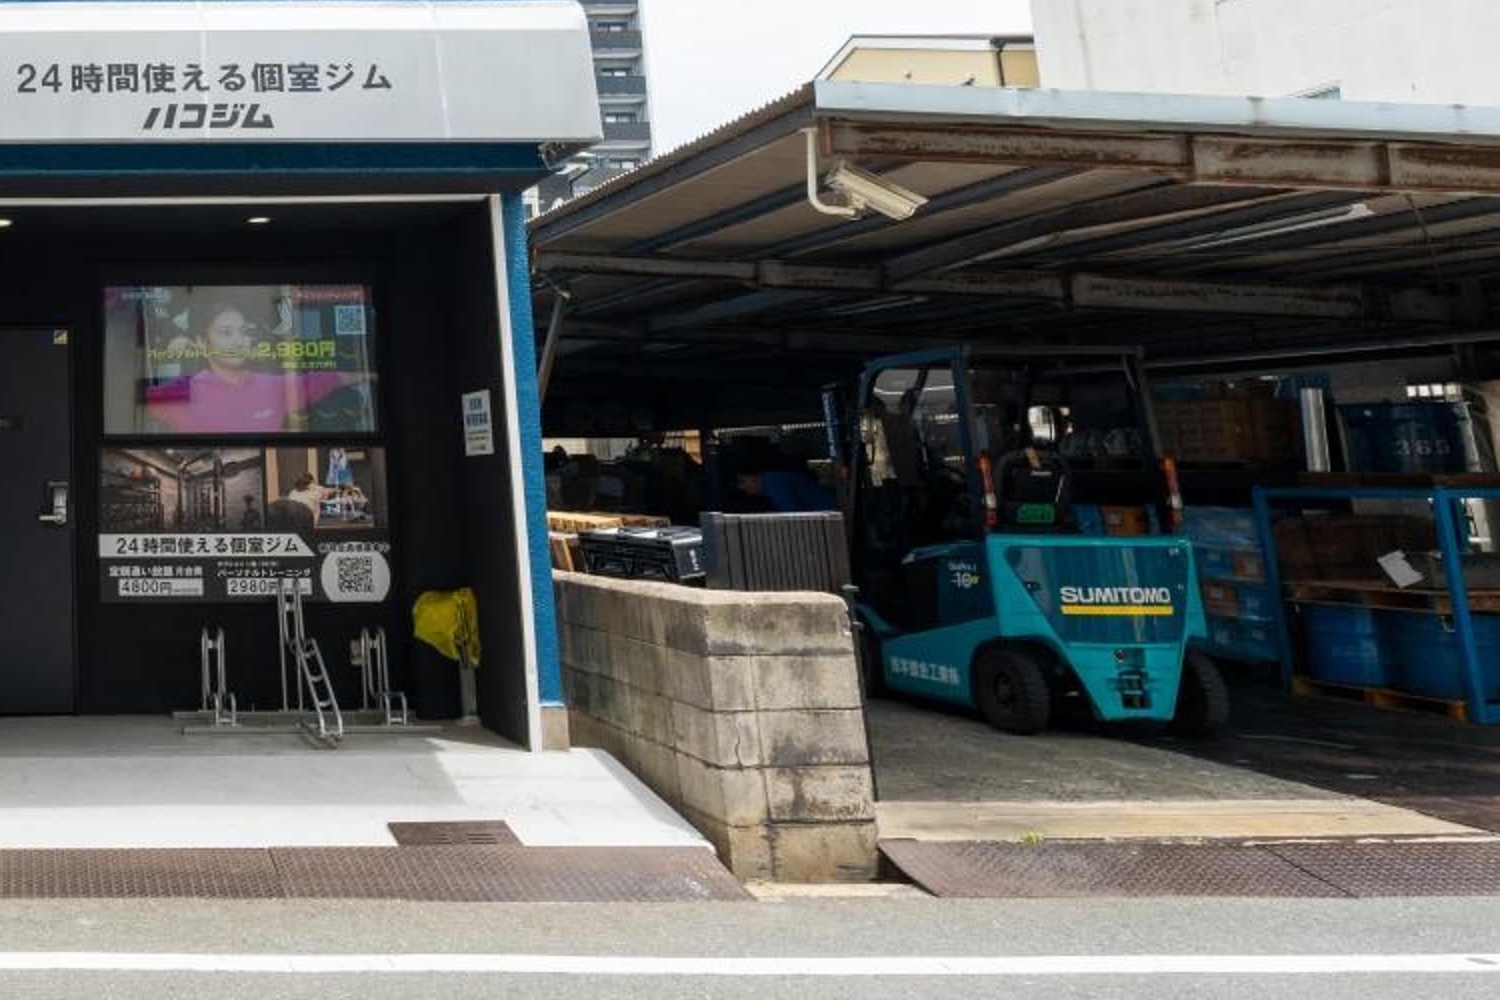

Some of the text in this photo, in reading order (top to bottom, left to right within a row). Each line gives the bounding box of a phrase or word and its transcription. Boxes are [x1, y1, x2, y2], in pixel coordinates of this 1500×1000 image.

[16, 62, 392, 94] 24時間使える個室ジム
[142, 103, 275, 129] ハコジム
[115, 536, 299, 555] 24時間使える個室ジム
[216, 568, 311, 577] パーソナルトレーニング
[121, 579, 173, 594] 4800円
[1059, 586, 1171, 604] SUMITOMO
